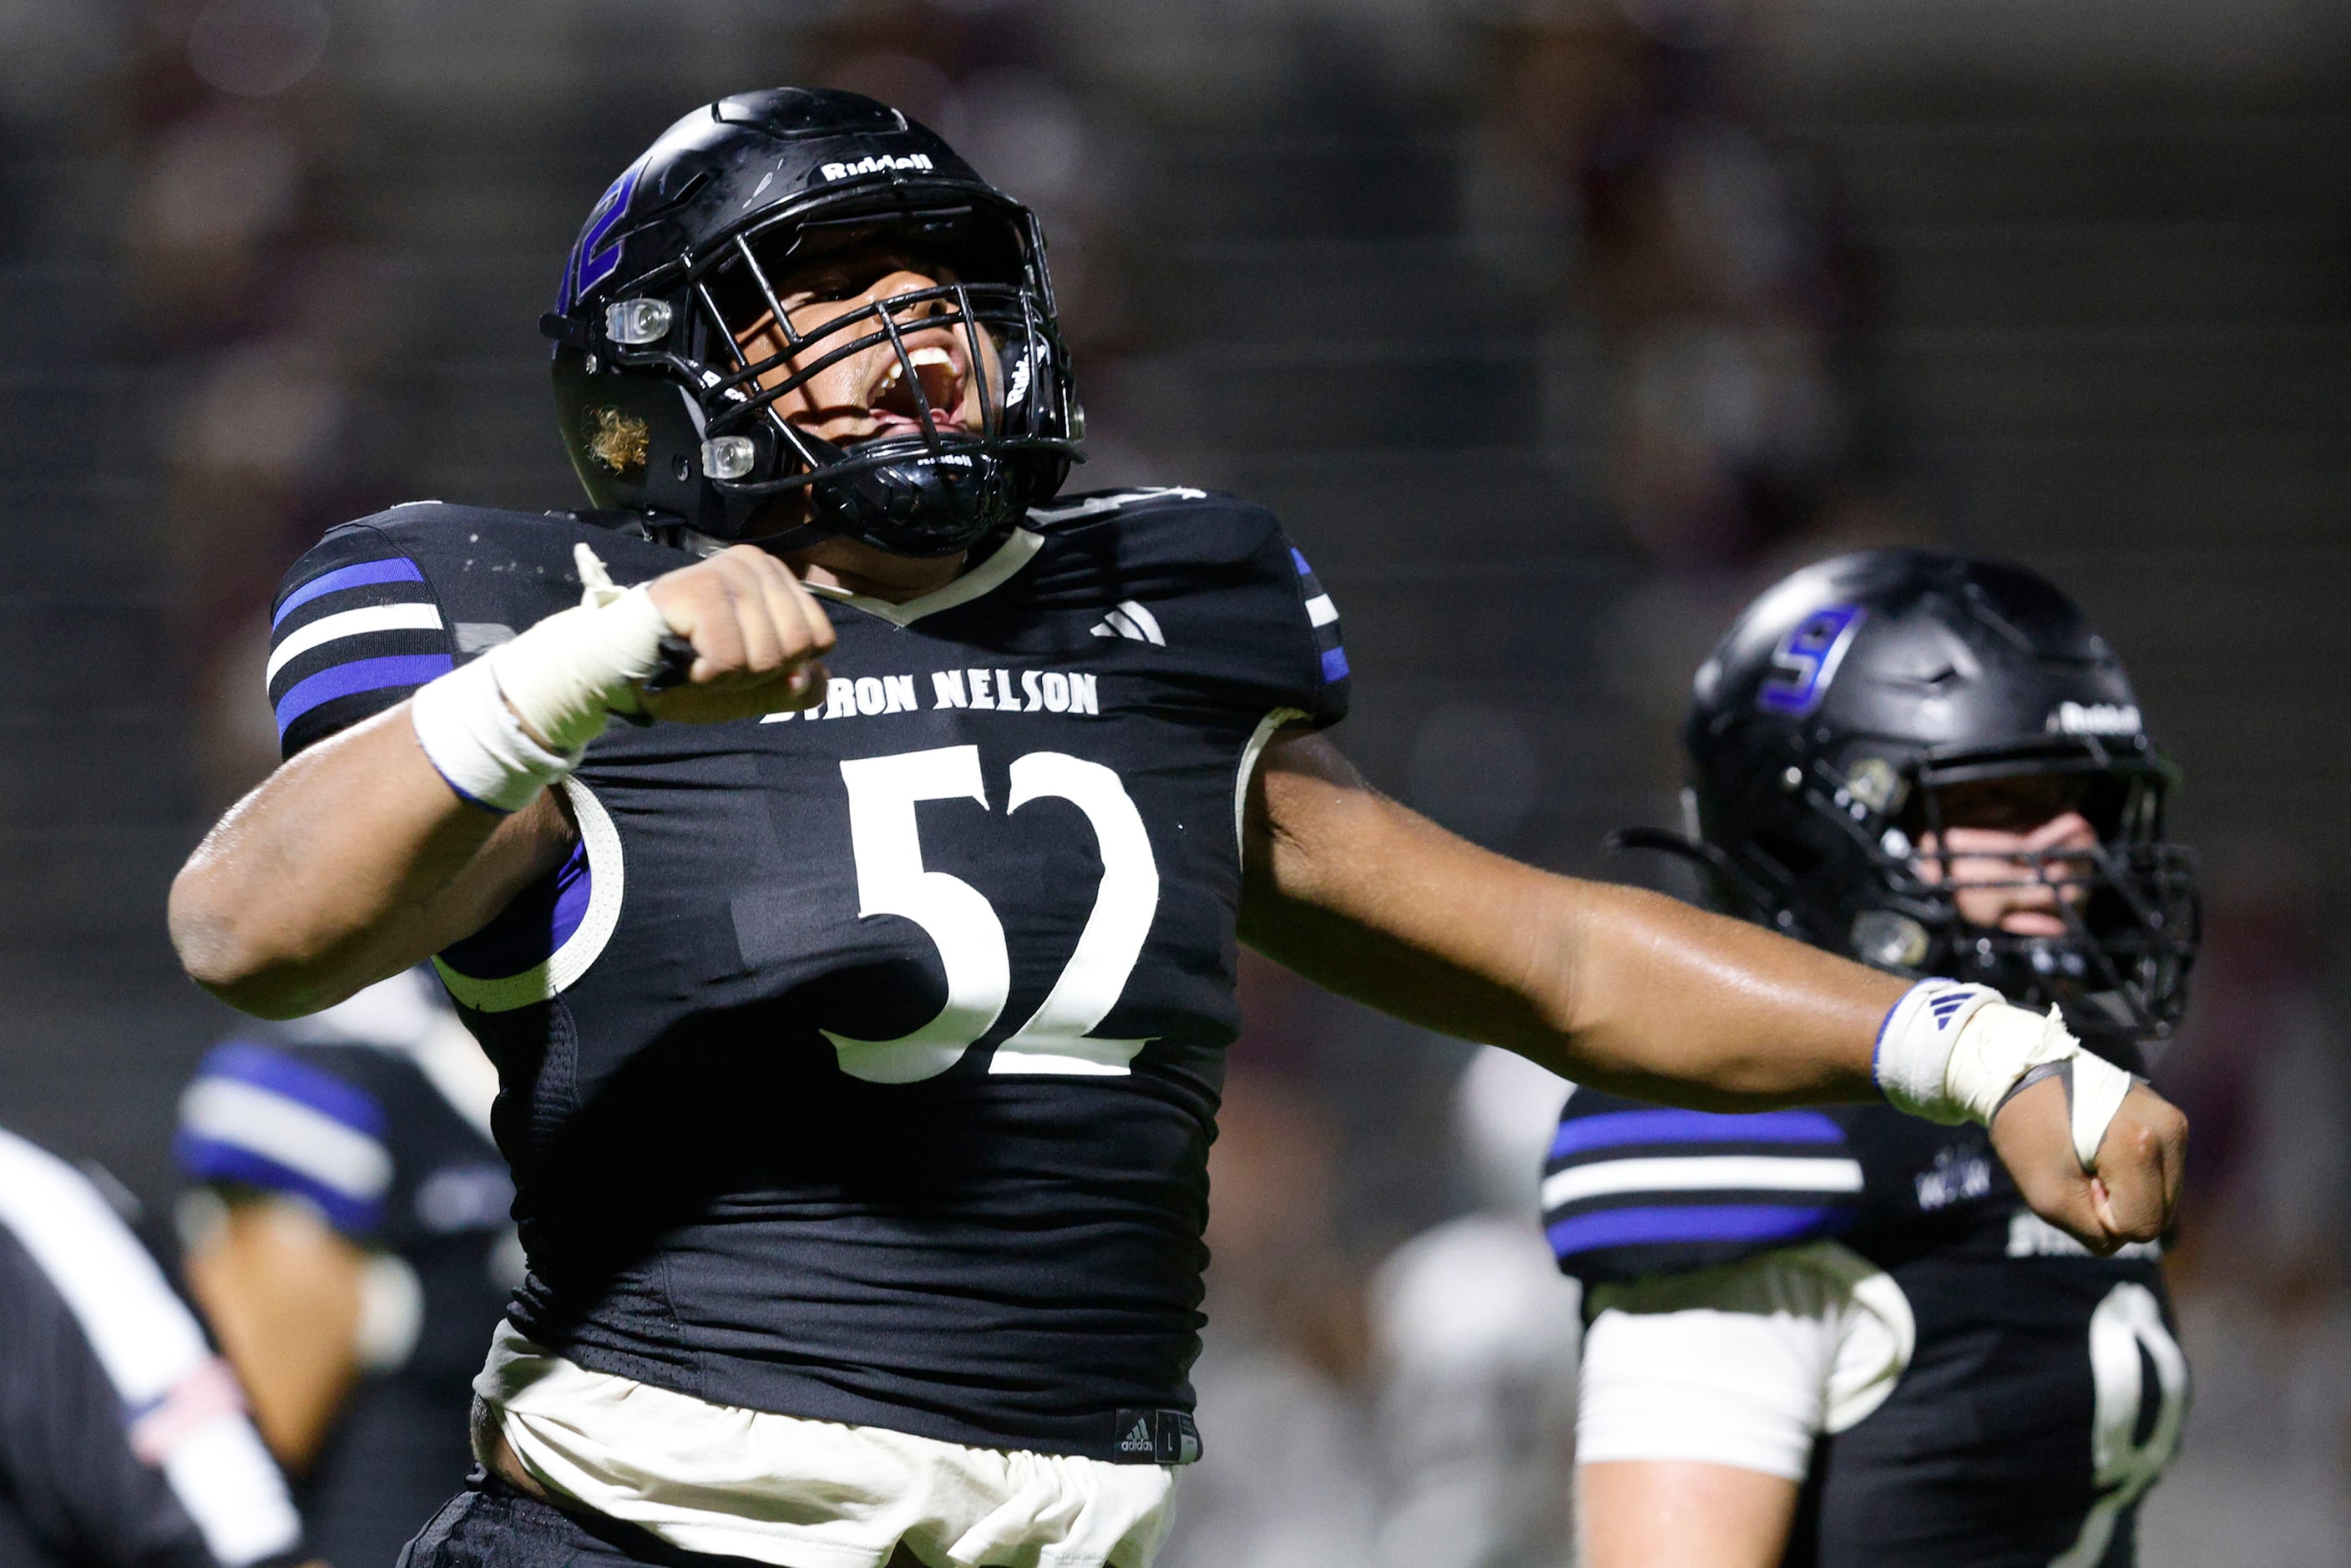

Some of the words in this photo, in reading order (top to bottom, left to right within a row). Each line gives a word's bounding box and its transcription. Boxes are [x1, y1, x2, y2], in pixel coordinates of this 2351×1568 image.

[821, 154, 933, 182] Riddell
[1757, 602, 1869, 718] 9
[758, 674, 918, 725] RON
[931, 668, 1100, 716] NELSON
[818, 744, 1162, 1085] 52
[1121, 1439, 1154, 1452] adidas
